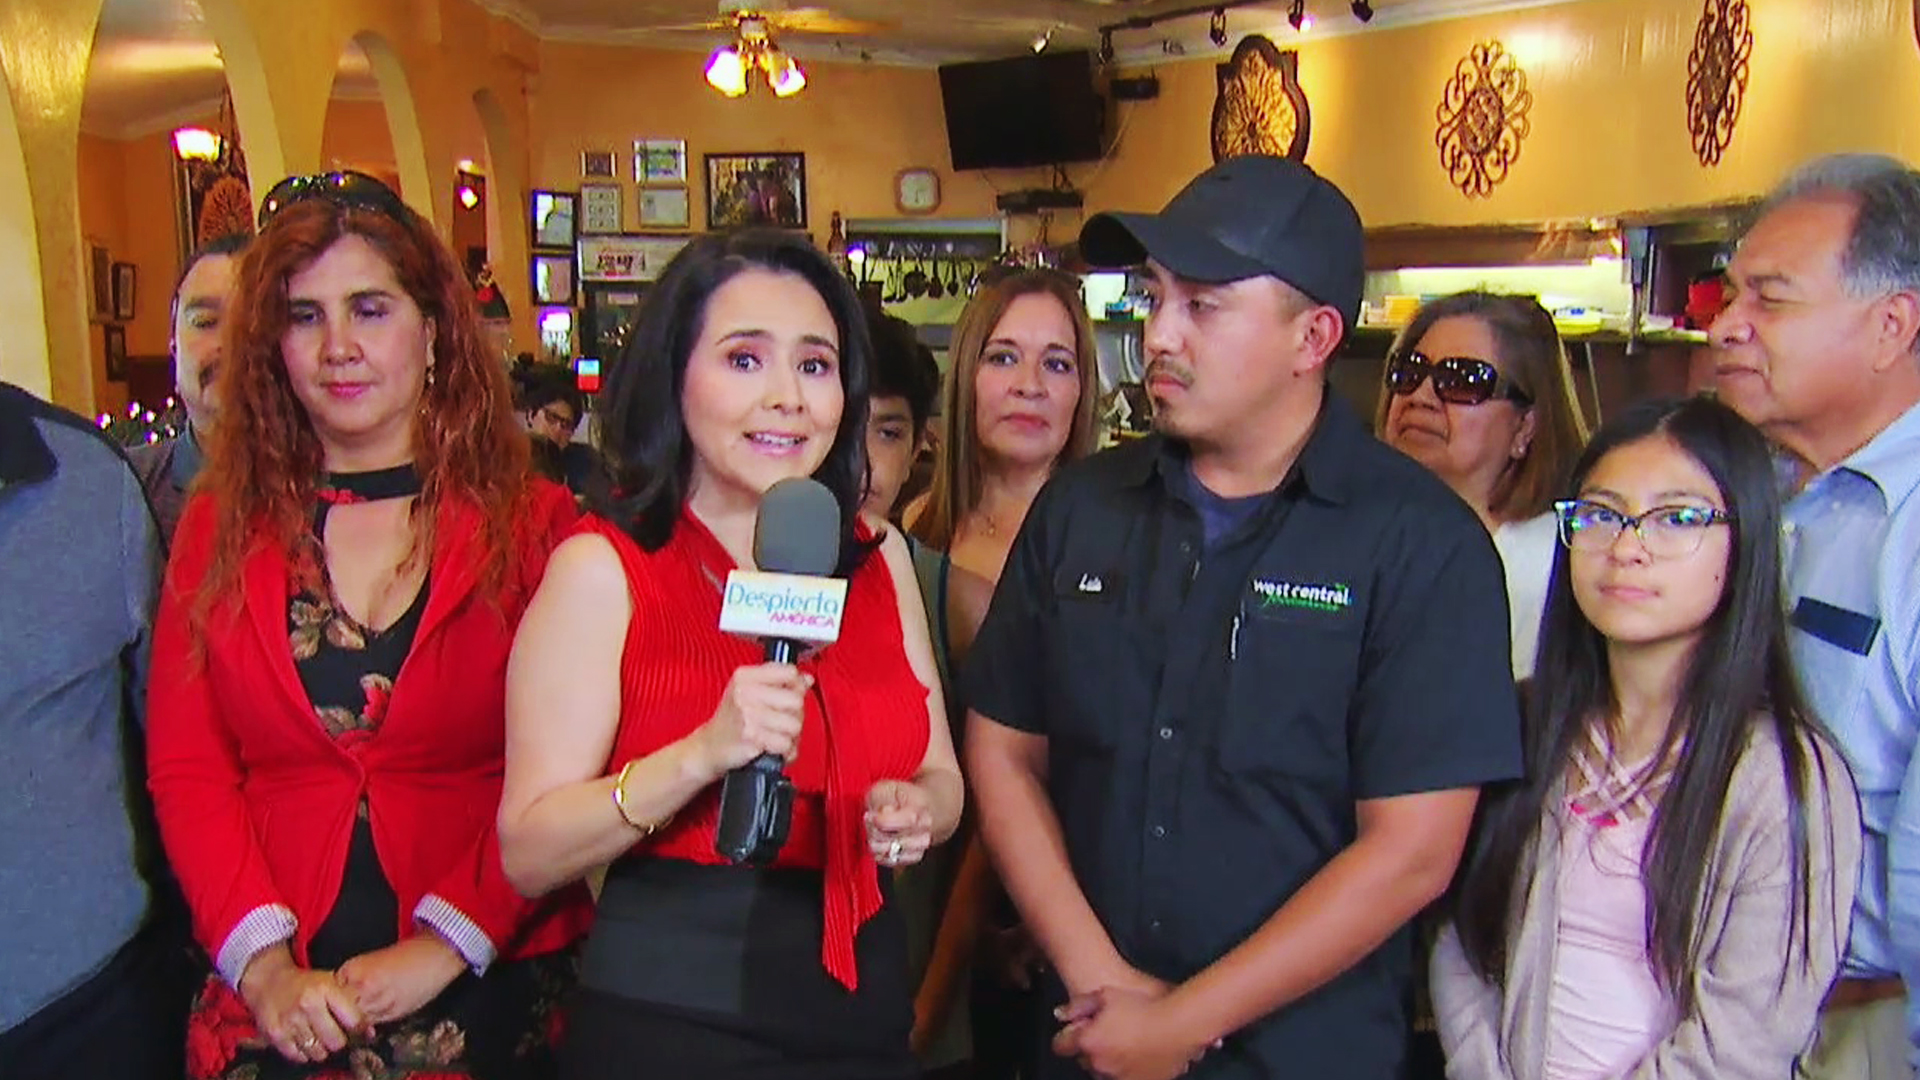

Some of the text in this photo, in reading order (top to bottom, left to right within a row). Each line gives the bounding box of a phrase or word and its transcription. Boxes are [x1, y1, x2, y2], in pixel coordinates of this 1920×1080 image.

[727, 582, 839, 615] Despierta
[1253, 579, 1290, 598] west
[1291, 586, 1349, 606] central
